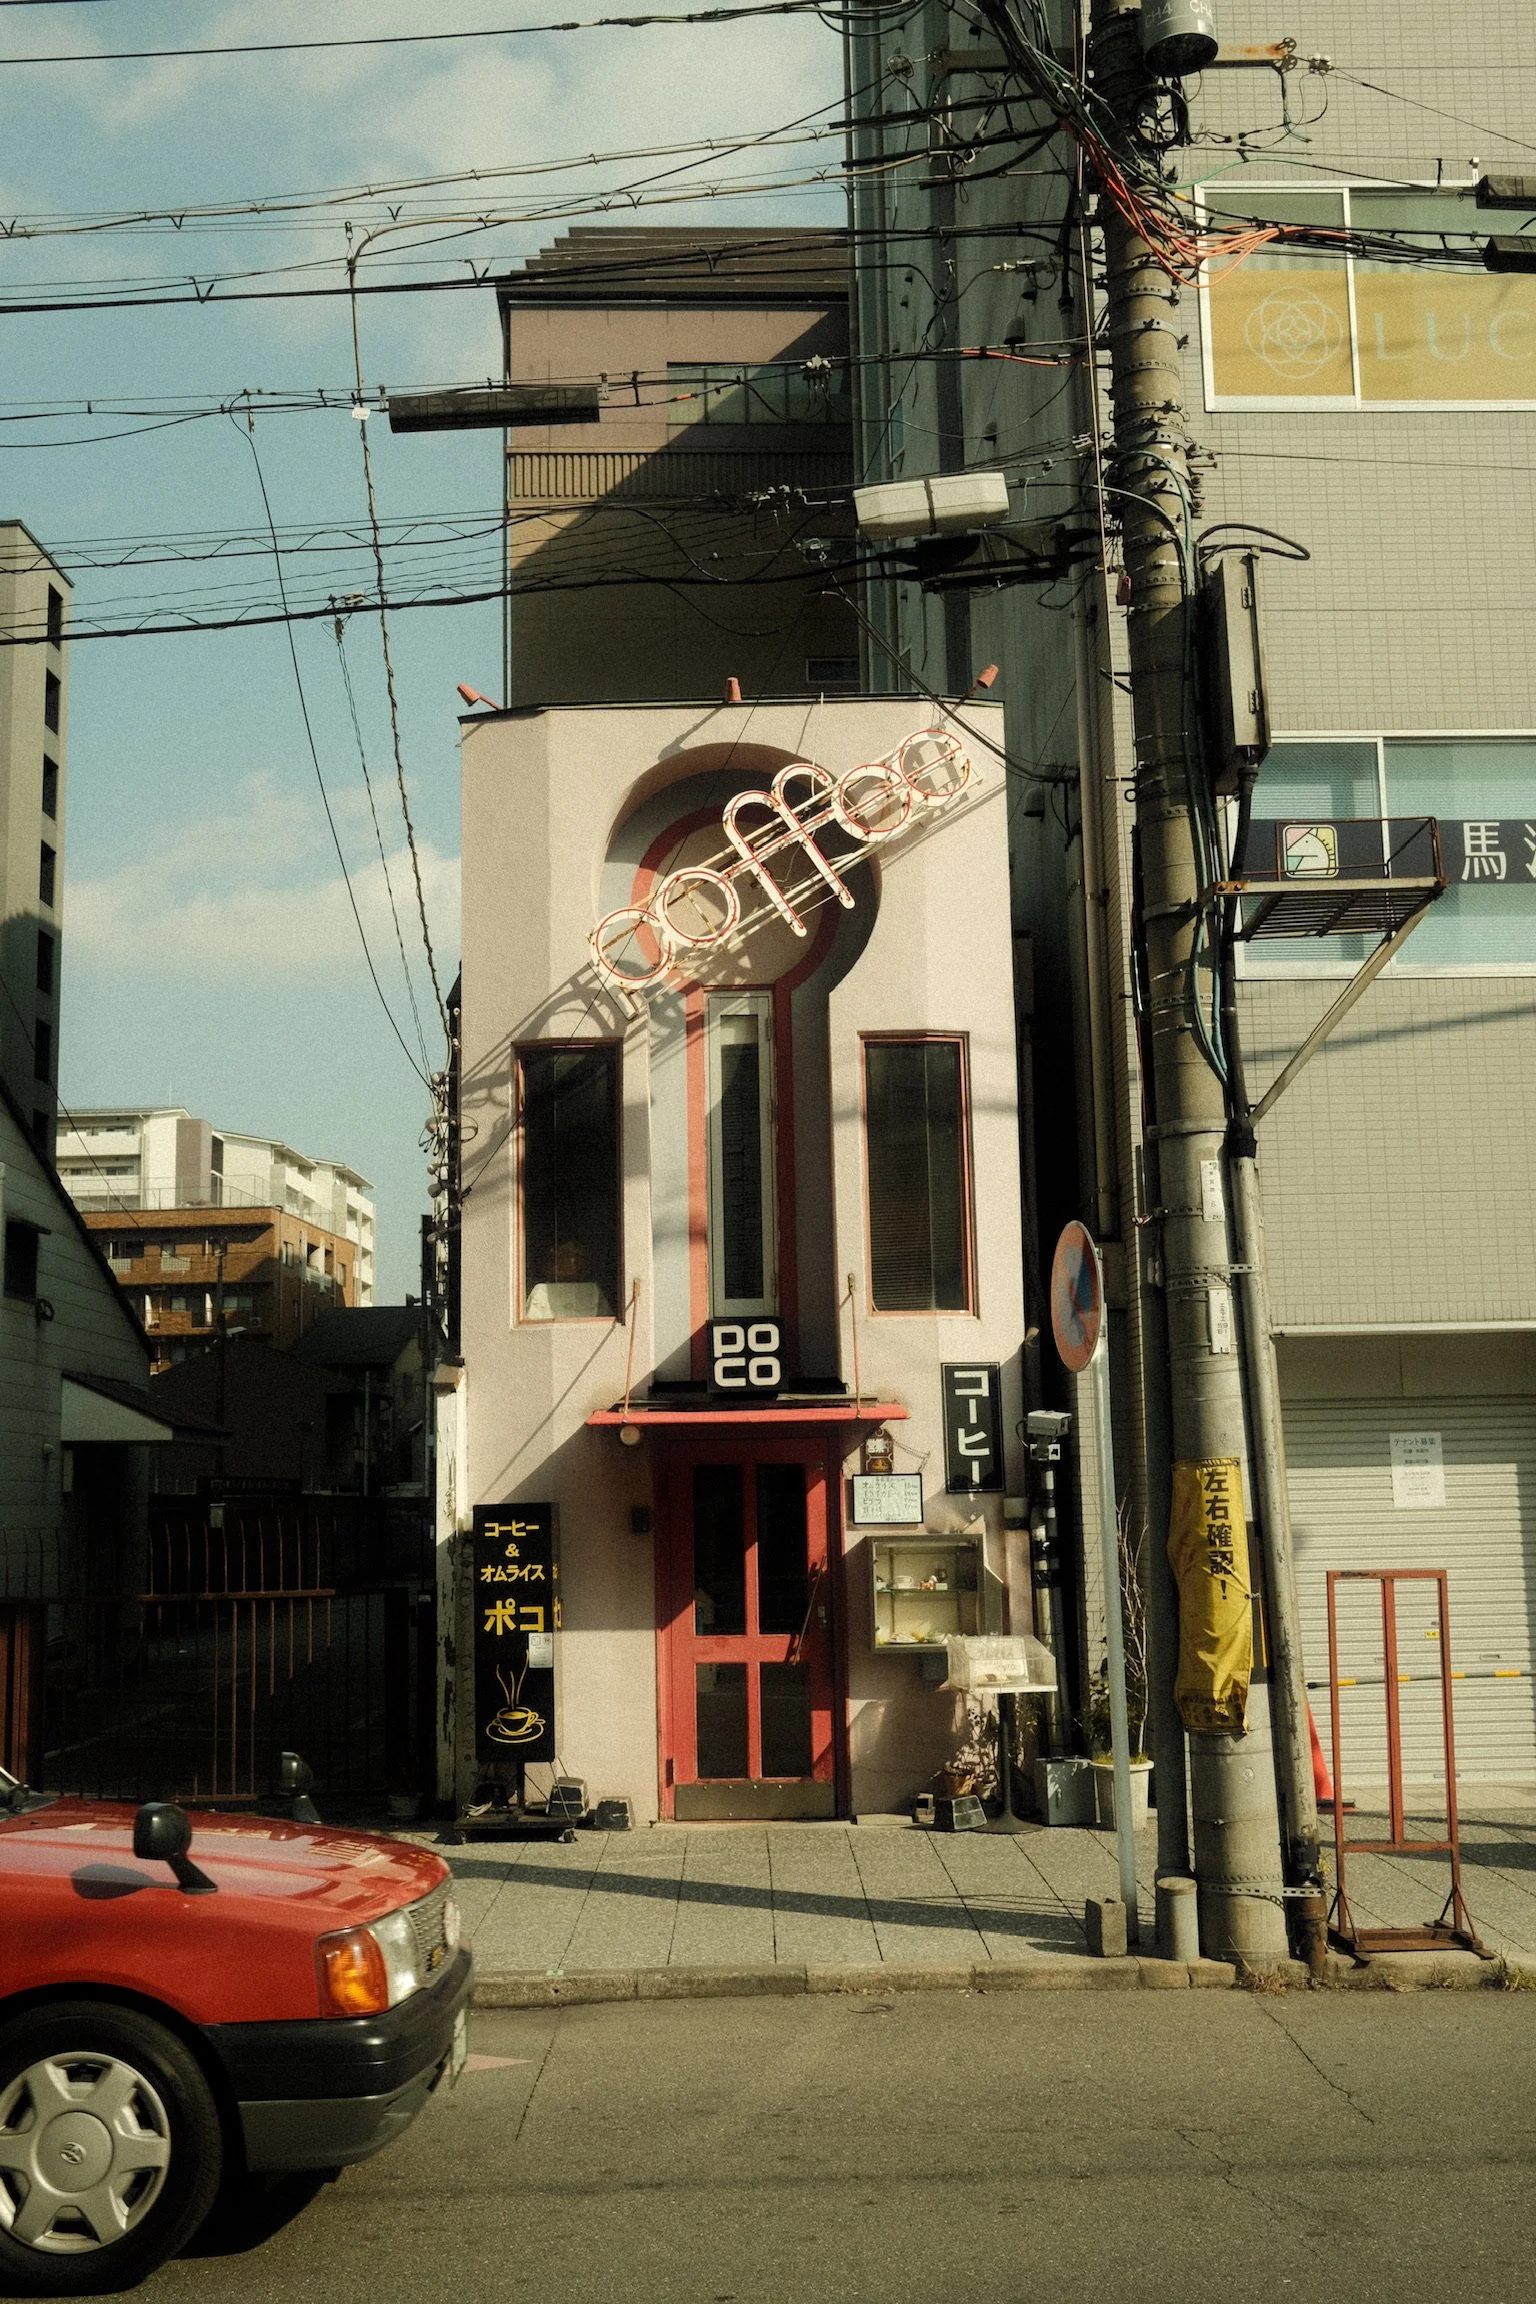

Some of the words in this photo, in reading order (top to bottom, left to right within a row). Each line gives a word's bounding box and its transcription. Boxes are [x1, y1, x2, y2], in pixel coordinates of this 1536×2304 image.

[590, 728, 972, 990] coffee
[953, 1370, 990, 1485] コーヒー
[484, 1520, 540, 1537] コーヒー
[504, 1543, 520, 1558] &
[480, 1563, 545, 1583] オムライス
[483, 1597, 545, 1636] ポコ
